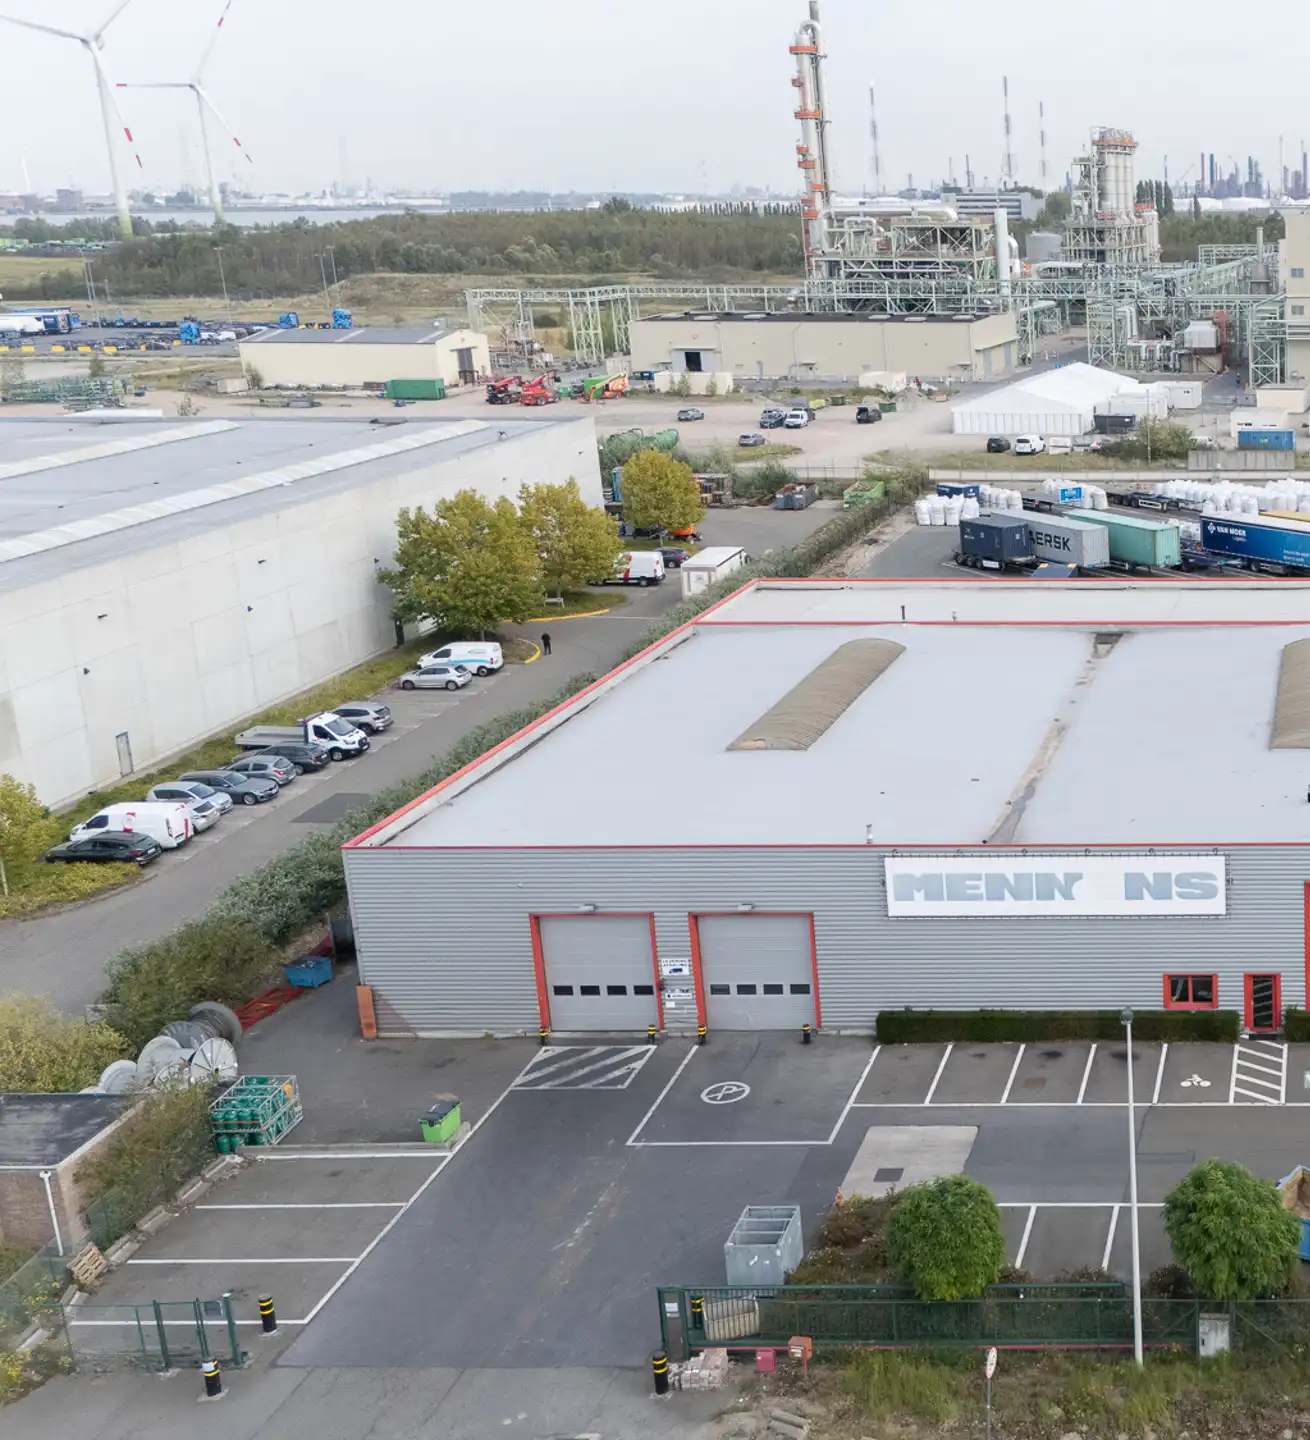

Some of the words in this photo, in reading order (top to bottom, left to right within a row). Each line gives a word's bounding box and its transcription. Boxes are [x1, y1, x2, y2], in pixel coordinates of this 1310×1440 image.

[1216, 525, 1229, 533] VAN
[1229, 527, 1246, 537] MOER
[1028, 530, 1071, 552] AERSK
